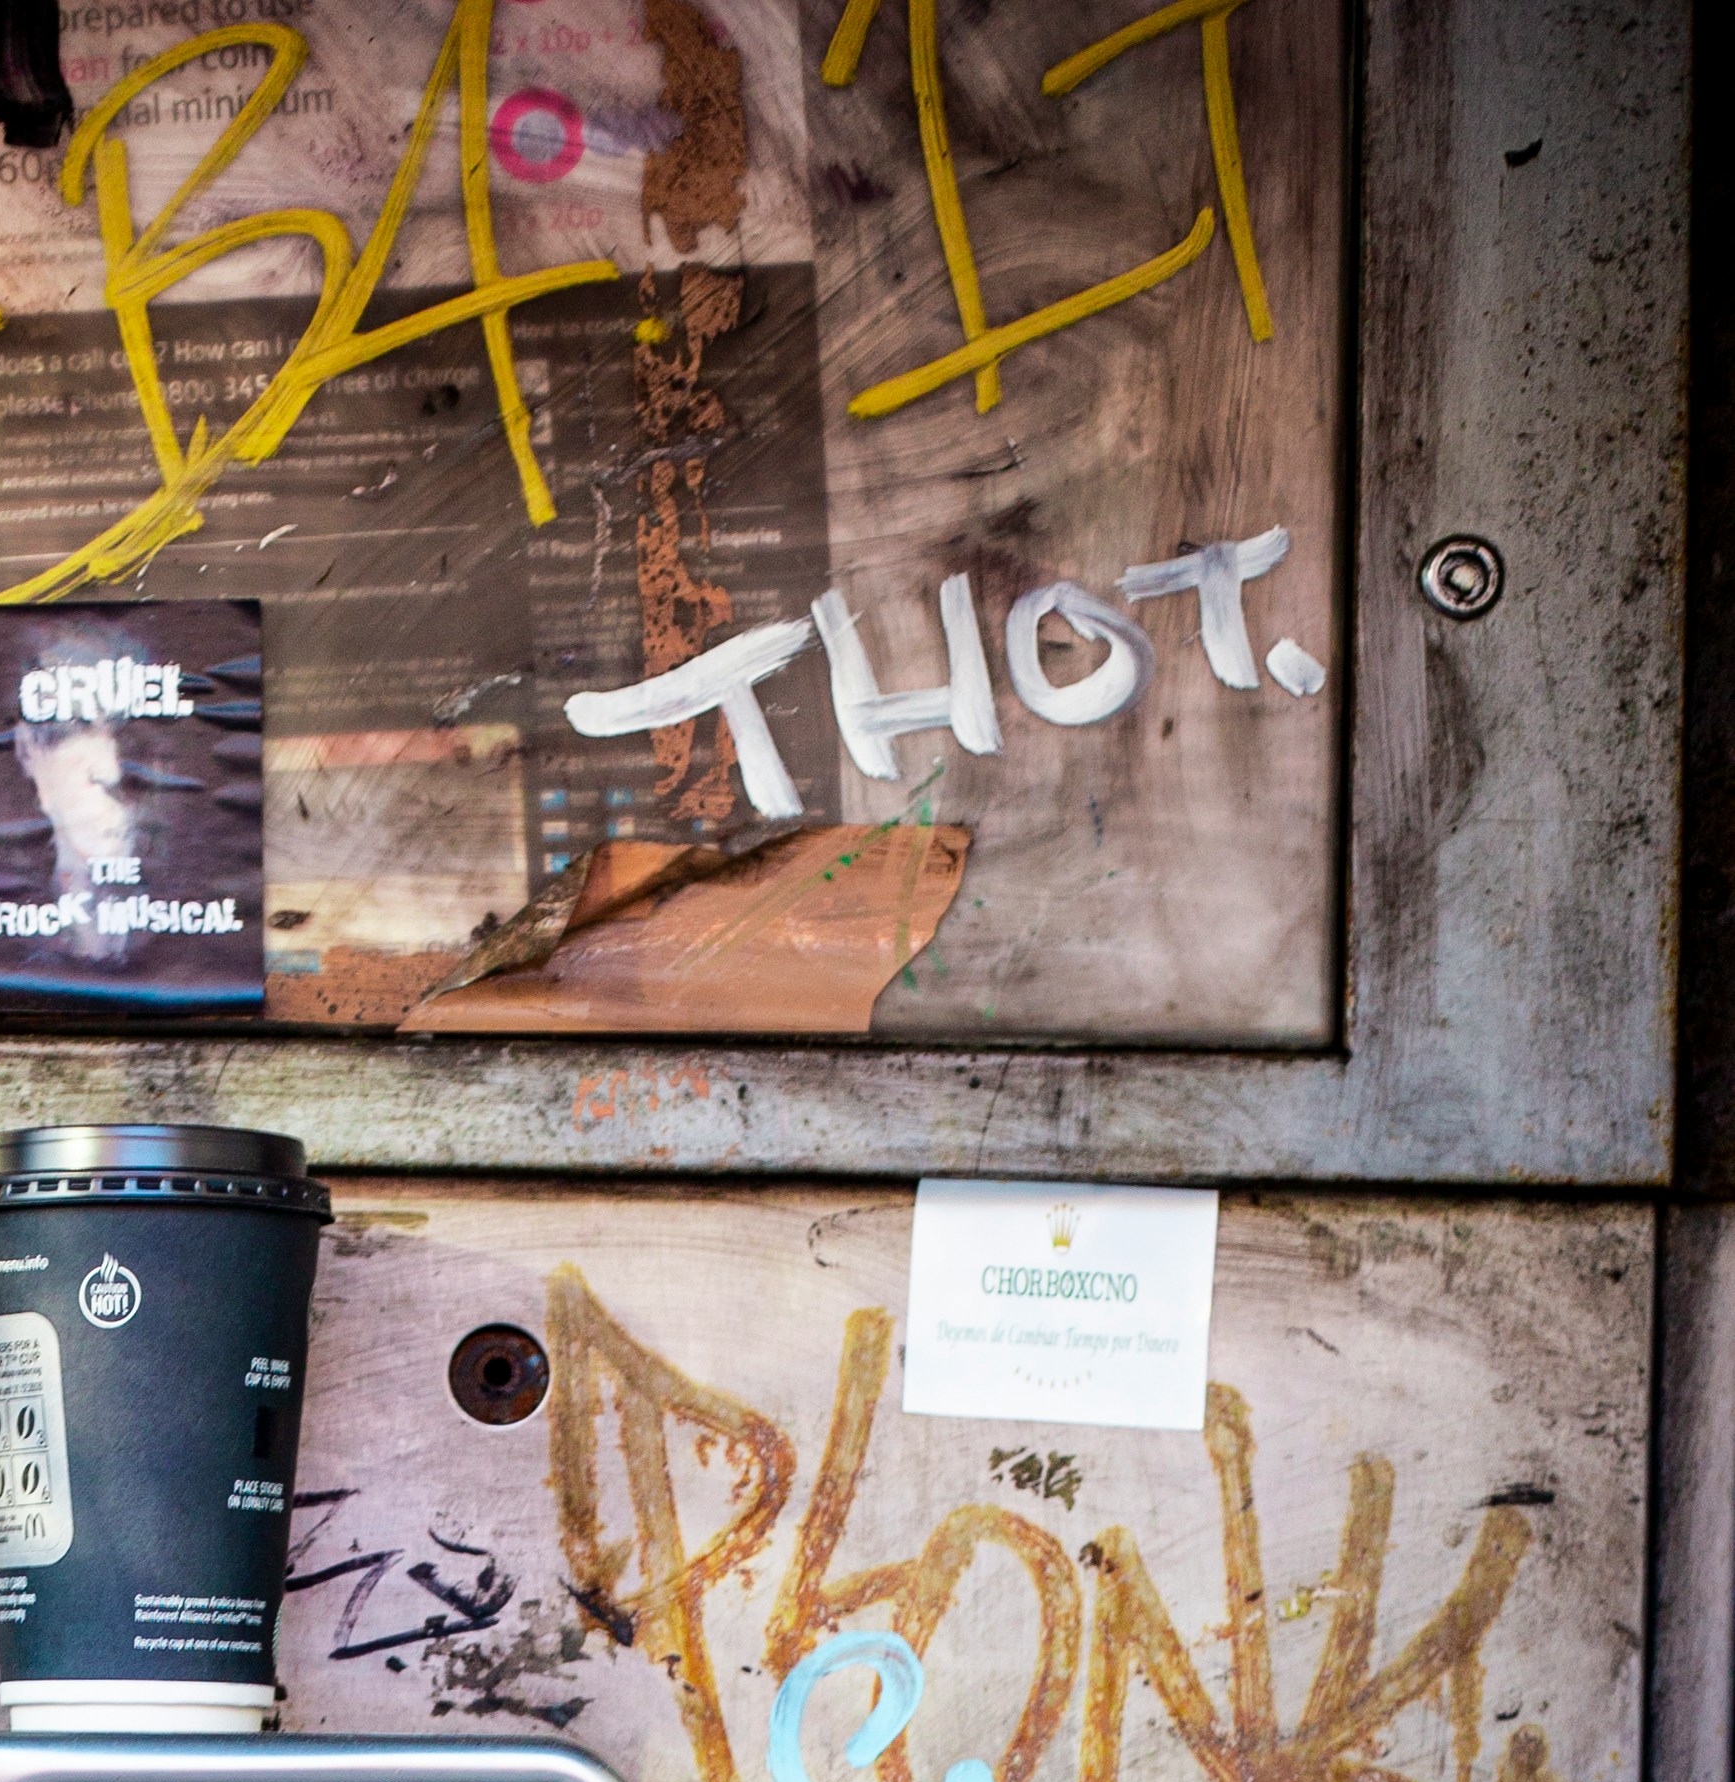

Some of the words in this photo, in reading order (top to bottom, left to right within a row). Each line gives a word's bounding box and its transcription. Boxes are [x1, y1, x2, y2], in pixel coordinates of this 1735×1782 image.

[171, 84, 335, 123] minium
[174, 339, 225, 362] How
[232, 338, 268, 361] can
[19, 655, 195, 723] CRUEL
[88, 855, 142, 885] THE
[96, 893, 244, 936] MUSICAL
[90, 1294, 130, 1316] HOT!
[133, 1635, 169, 1652] Recycle
[168, 1638, 186, 1653] cup
